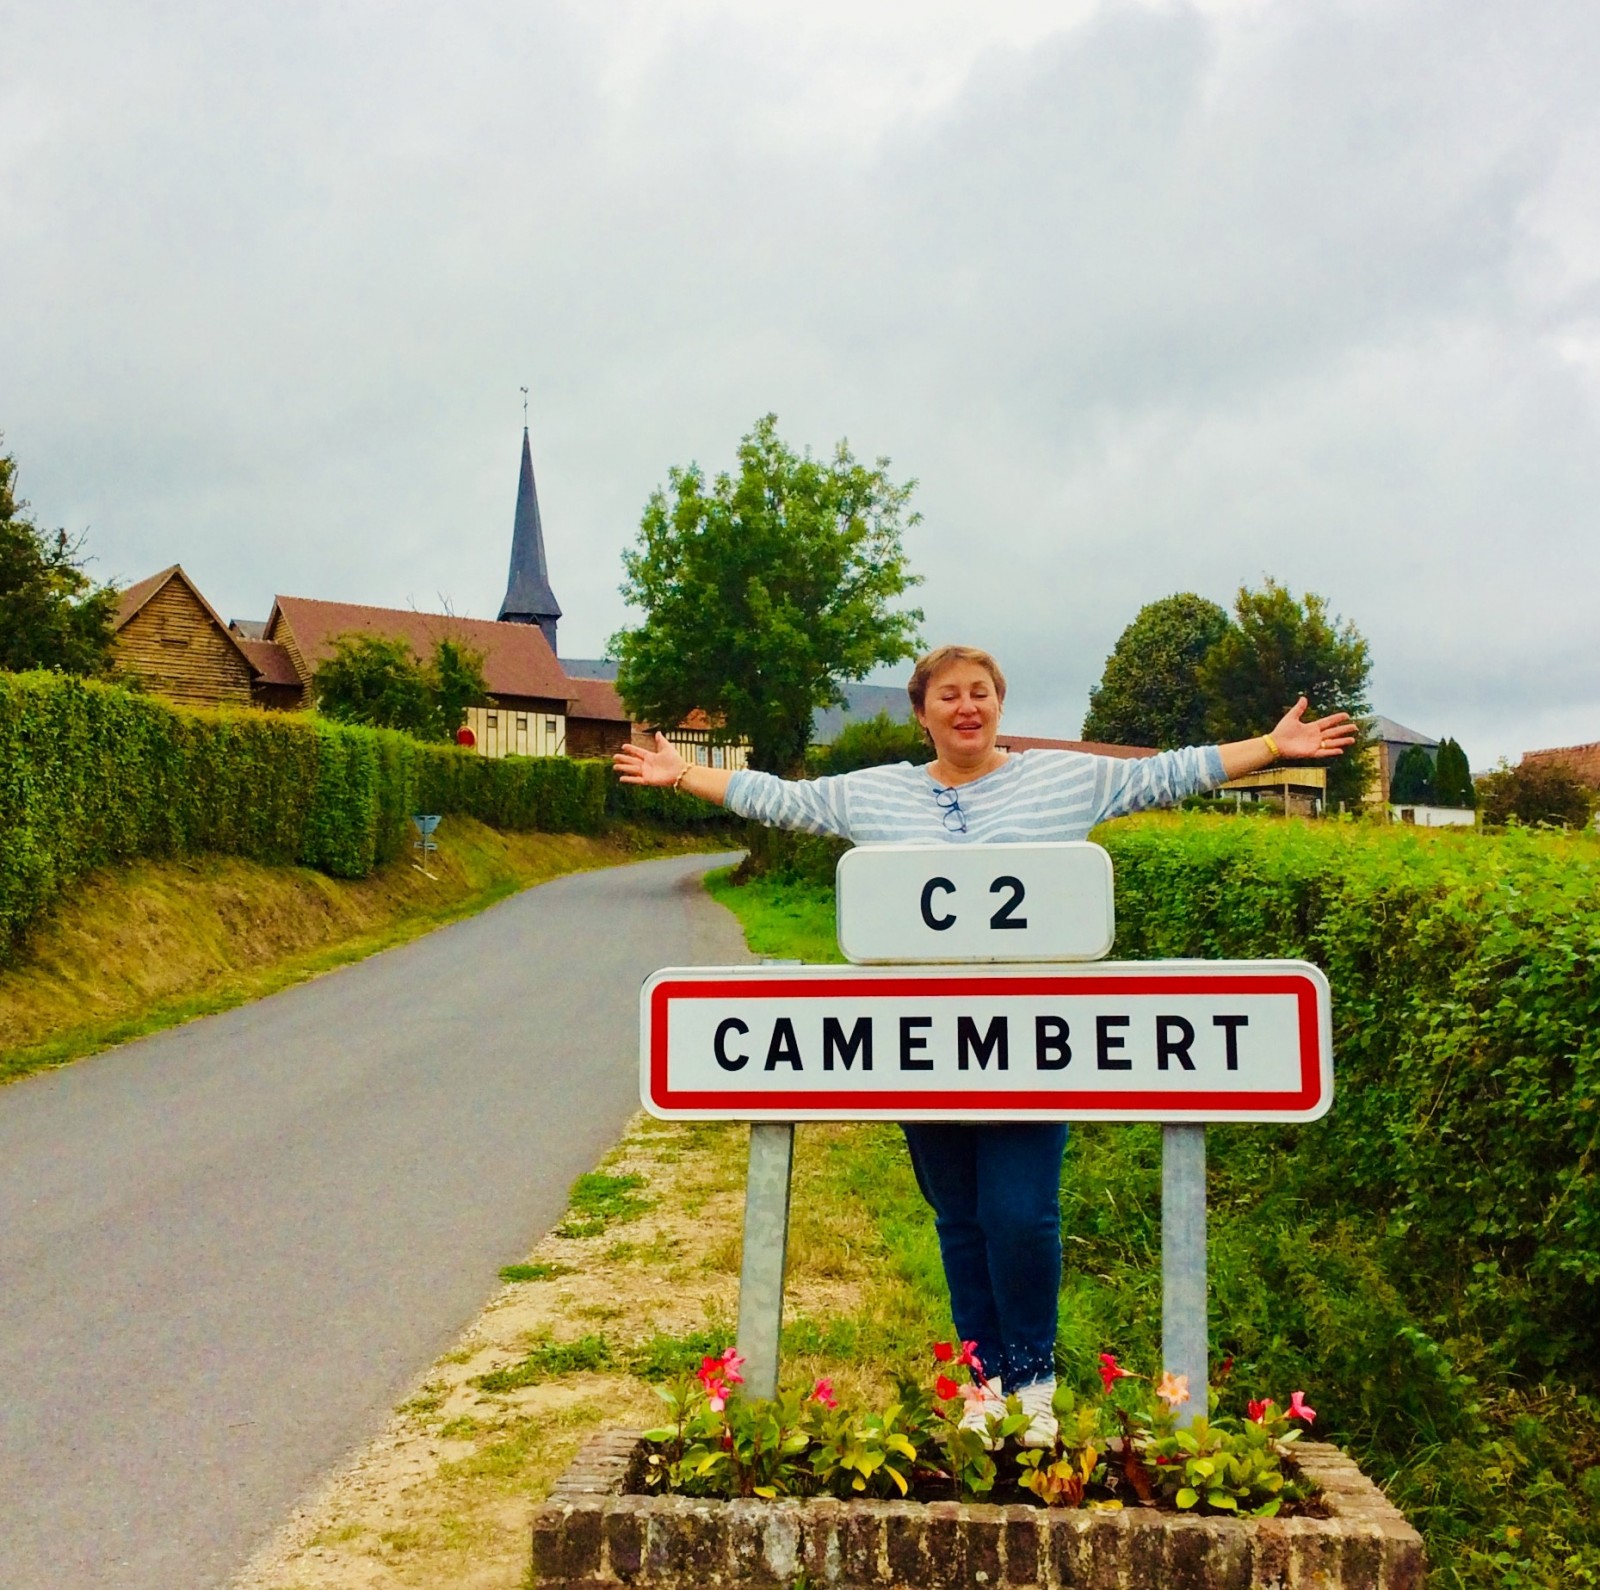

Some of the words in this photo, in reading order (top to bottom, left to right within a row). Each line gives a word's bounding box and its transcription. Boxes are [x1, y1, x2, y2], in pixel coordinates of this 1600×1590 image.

[920, 876, 957, 932] C
[989, 875, 1028, 930] 2
[713, 1014, 1249, 1072] CAMEMBERT
